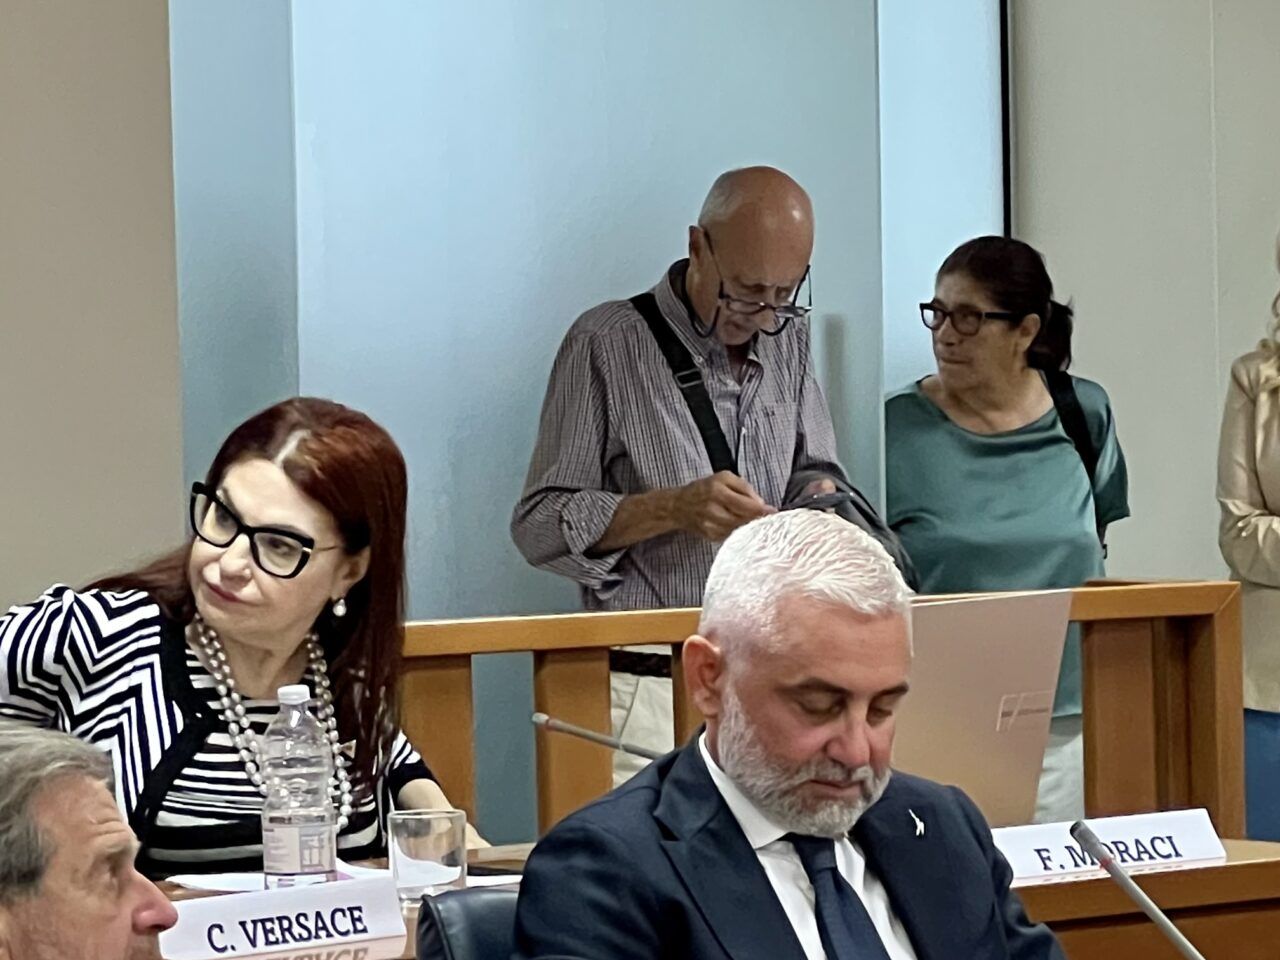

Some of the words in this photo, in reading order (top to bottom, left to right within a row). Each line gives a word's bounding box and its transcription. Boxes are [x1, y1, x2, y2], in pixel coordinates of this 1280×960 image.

[1034, 847, 1065, 871] F.
[207, 923, 236, 953] C.
[238, 905, 369, 948] VERSACE
